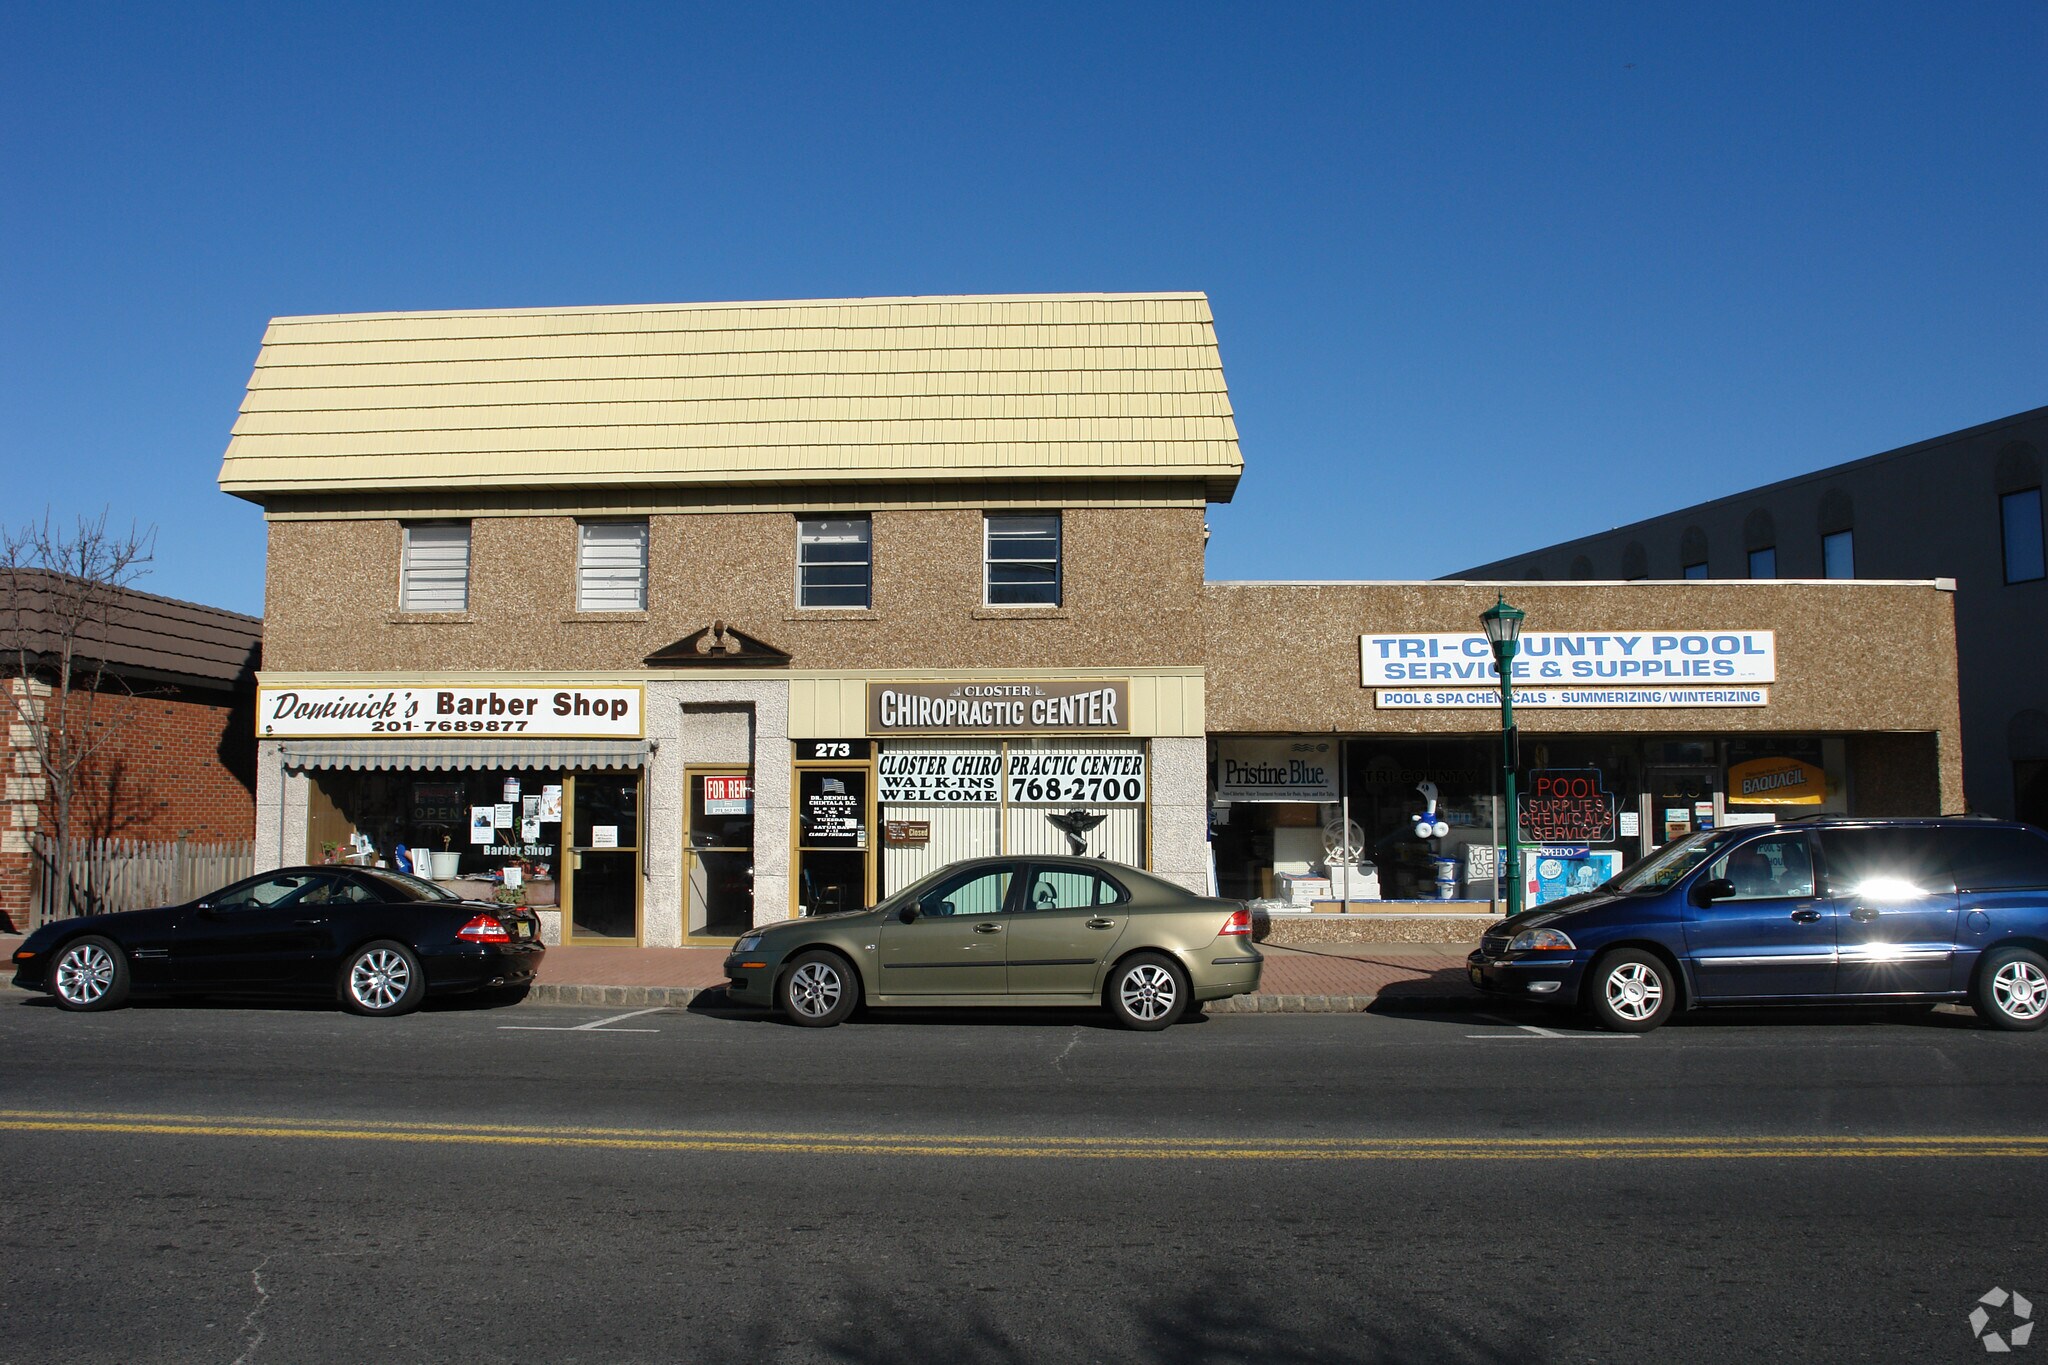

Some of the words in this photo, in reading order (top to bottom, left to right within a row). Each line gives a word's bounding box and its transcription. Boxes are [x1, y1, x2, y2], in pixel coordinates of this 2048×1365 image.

[1372, 636, 1641, 659] TRI-CUNTY
[1652, 635, 1765, 655] POOL
[1540, 661, 1562, 678] &
[1572, 659, 1735, 677] SUPPLIES
[964, 685, 1032, 697] CLOSTER
[1384, 693, 1420, 704] POOL
[1424, 693, 1433, 704] &
[1436, 693, 1464, 704] SPA
[1467, 692, 1547, 704] CHECALS
[1561, 691, 1761, 703] SUMMERIZING/WINTERIZING
[273, 692, 419, 720] Dominick's
[436, 692, 538, 715] Barber
[553, 692, 629, 721] Shop
[881, 690, 1024, 726] CHIROPRACTIC
[1031, 687, 1118, 725] CENTER
[815, 743, 850, 757] 273
[879, 756, 947, 775] CLOSTER
[952, 756, 1003, 776] CHIRO
[1008, 756, 1078, 776] PRACTIC
[1080, 756, 1143, 776] CENTER
[1225, 760, 1288, 785] Pristine
[883, 777, 995, 788] WALK-INS
[1537, 777, 1603, 799] POOL
[1743, 769, 1807, 795] BAQUACIL
[708, 780, 725, 799] FOR
[880, 790, 998, 801] WELCOME
[1012, 778, 1141, 802] 768-2700
[1529, 799, 1605, 812] SUPPLIES
[415, 807, 459, 820] OPEN
[1519, 812, 1613, 826] CHEMICALS
[909, 828, 928, 837] Closed
[1533, 826, 1602, 840] SERVICE
[483, 845, 522, 856] Barber
[524, 844, 552, 857] Shop
[1542, 847, 1574, 857] SPEEDO
